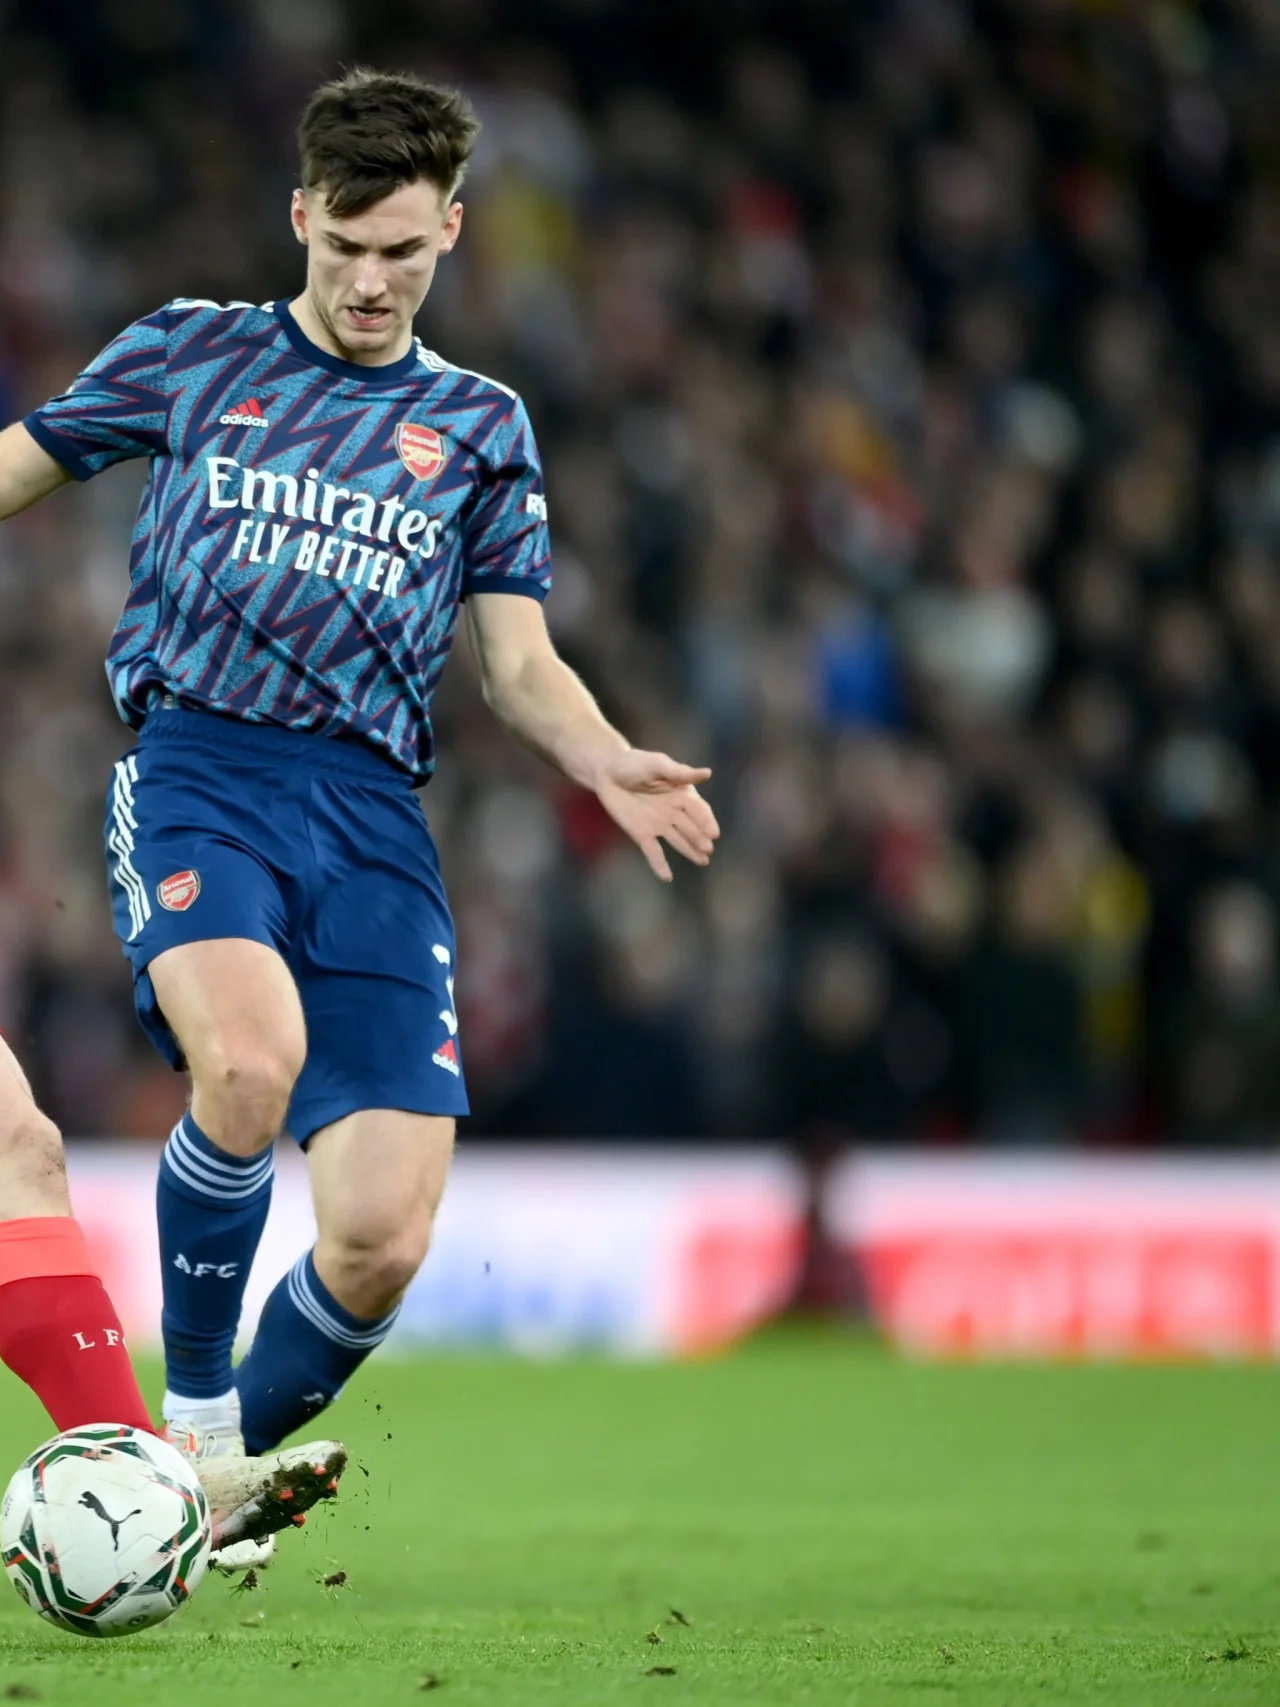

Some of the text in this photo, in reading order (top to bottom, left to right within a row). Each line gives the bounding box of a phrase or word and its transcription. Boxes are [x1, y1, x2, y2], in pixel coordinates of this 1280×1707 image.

[220, 414, 269, 428] adidas
[402, 430, 440, 447] Arsenal
[206, 456, 443, 560] Emirates
[231, 518, 406, 599] FLY BETTER
[164, 876, 194, 892] Arsenal
[173, 1253, 239, 1279] AFC
